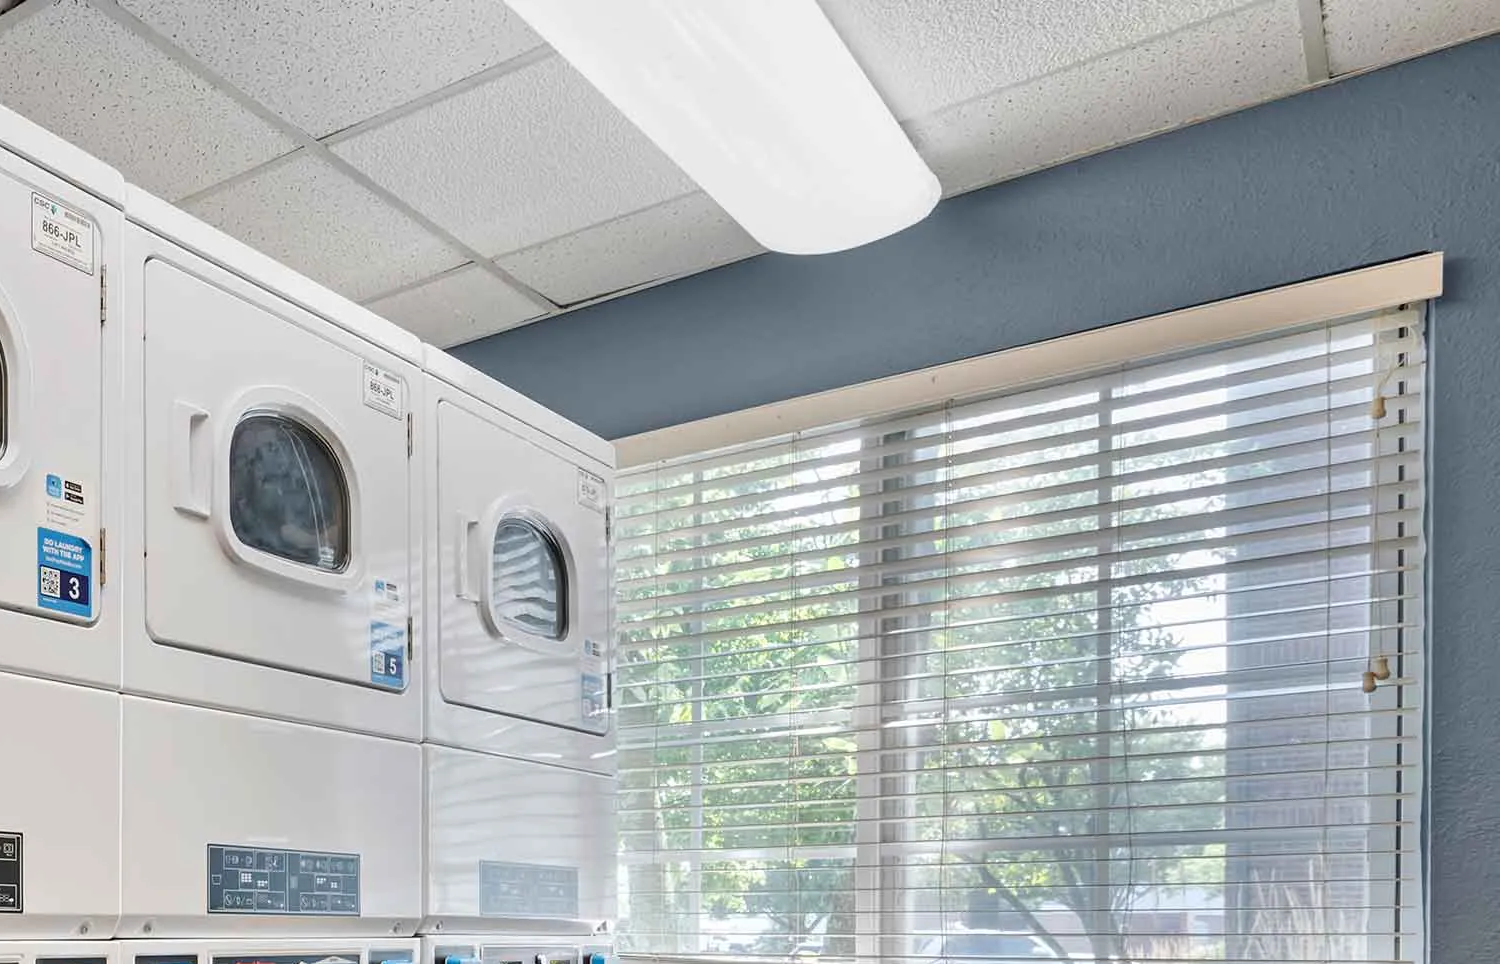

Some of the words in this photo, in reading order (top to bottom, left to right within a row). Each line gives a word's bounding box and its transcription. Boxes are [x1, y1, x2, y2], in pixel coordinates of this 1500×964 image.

[42, 220, 81, 248] 866-JPL
[69, 577, 80, 599] 3
[390, 658, 396, 674] 5
